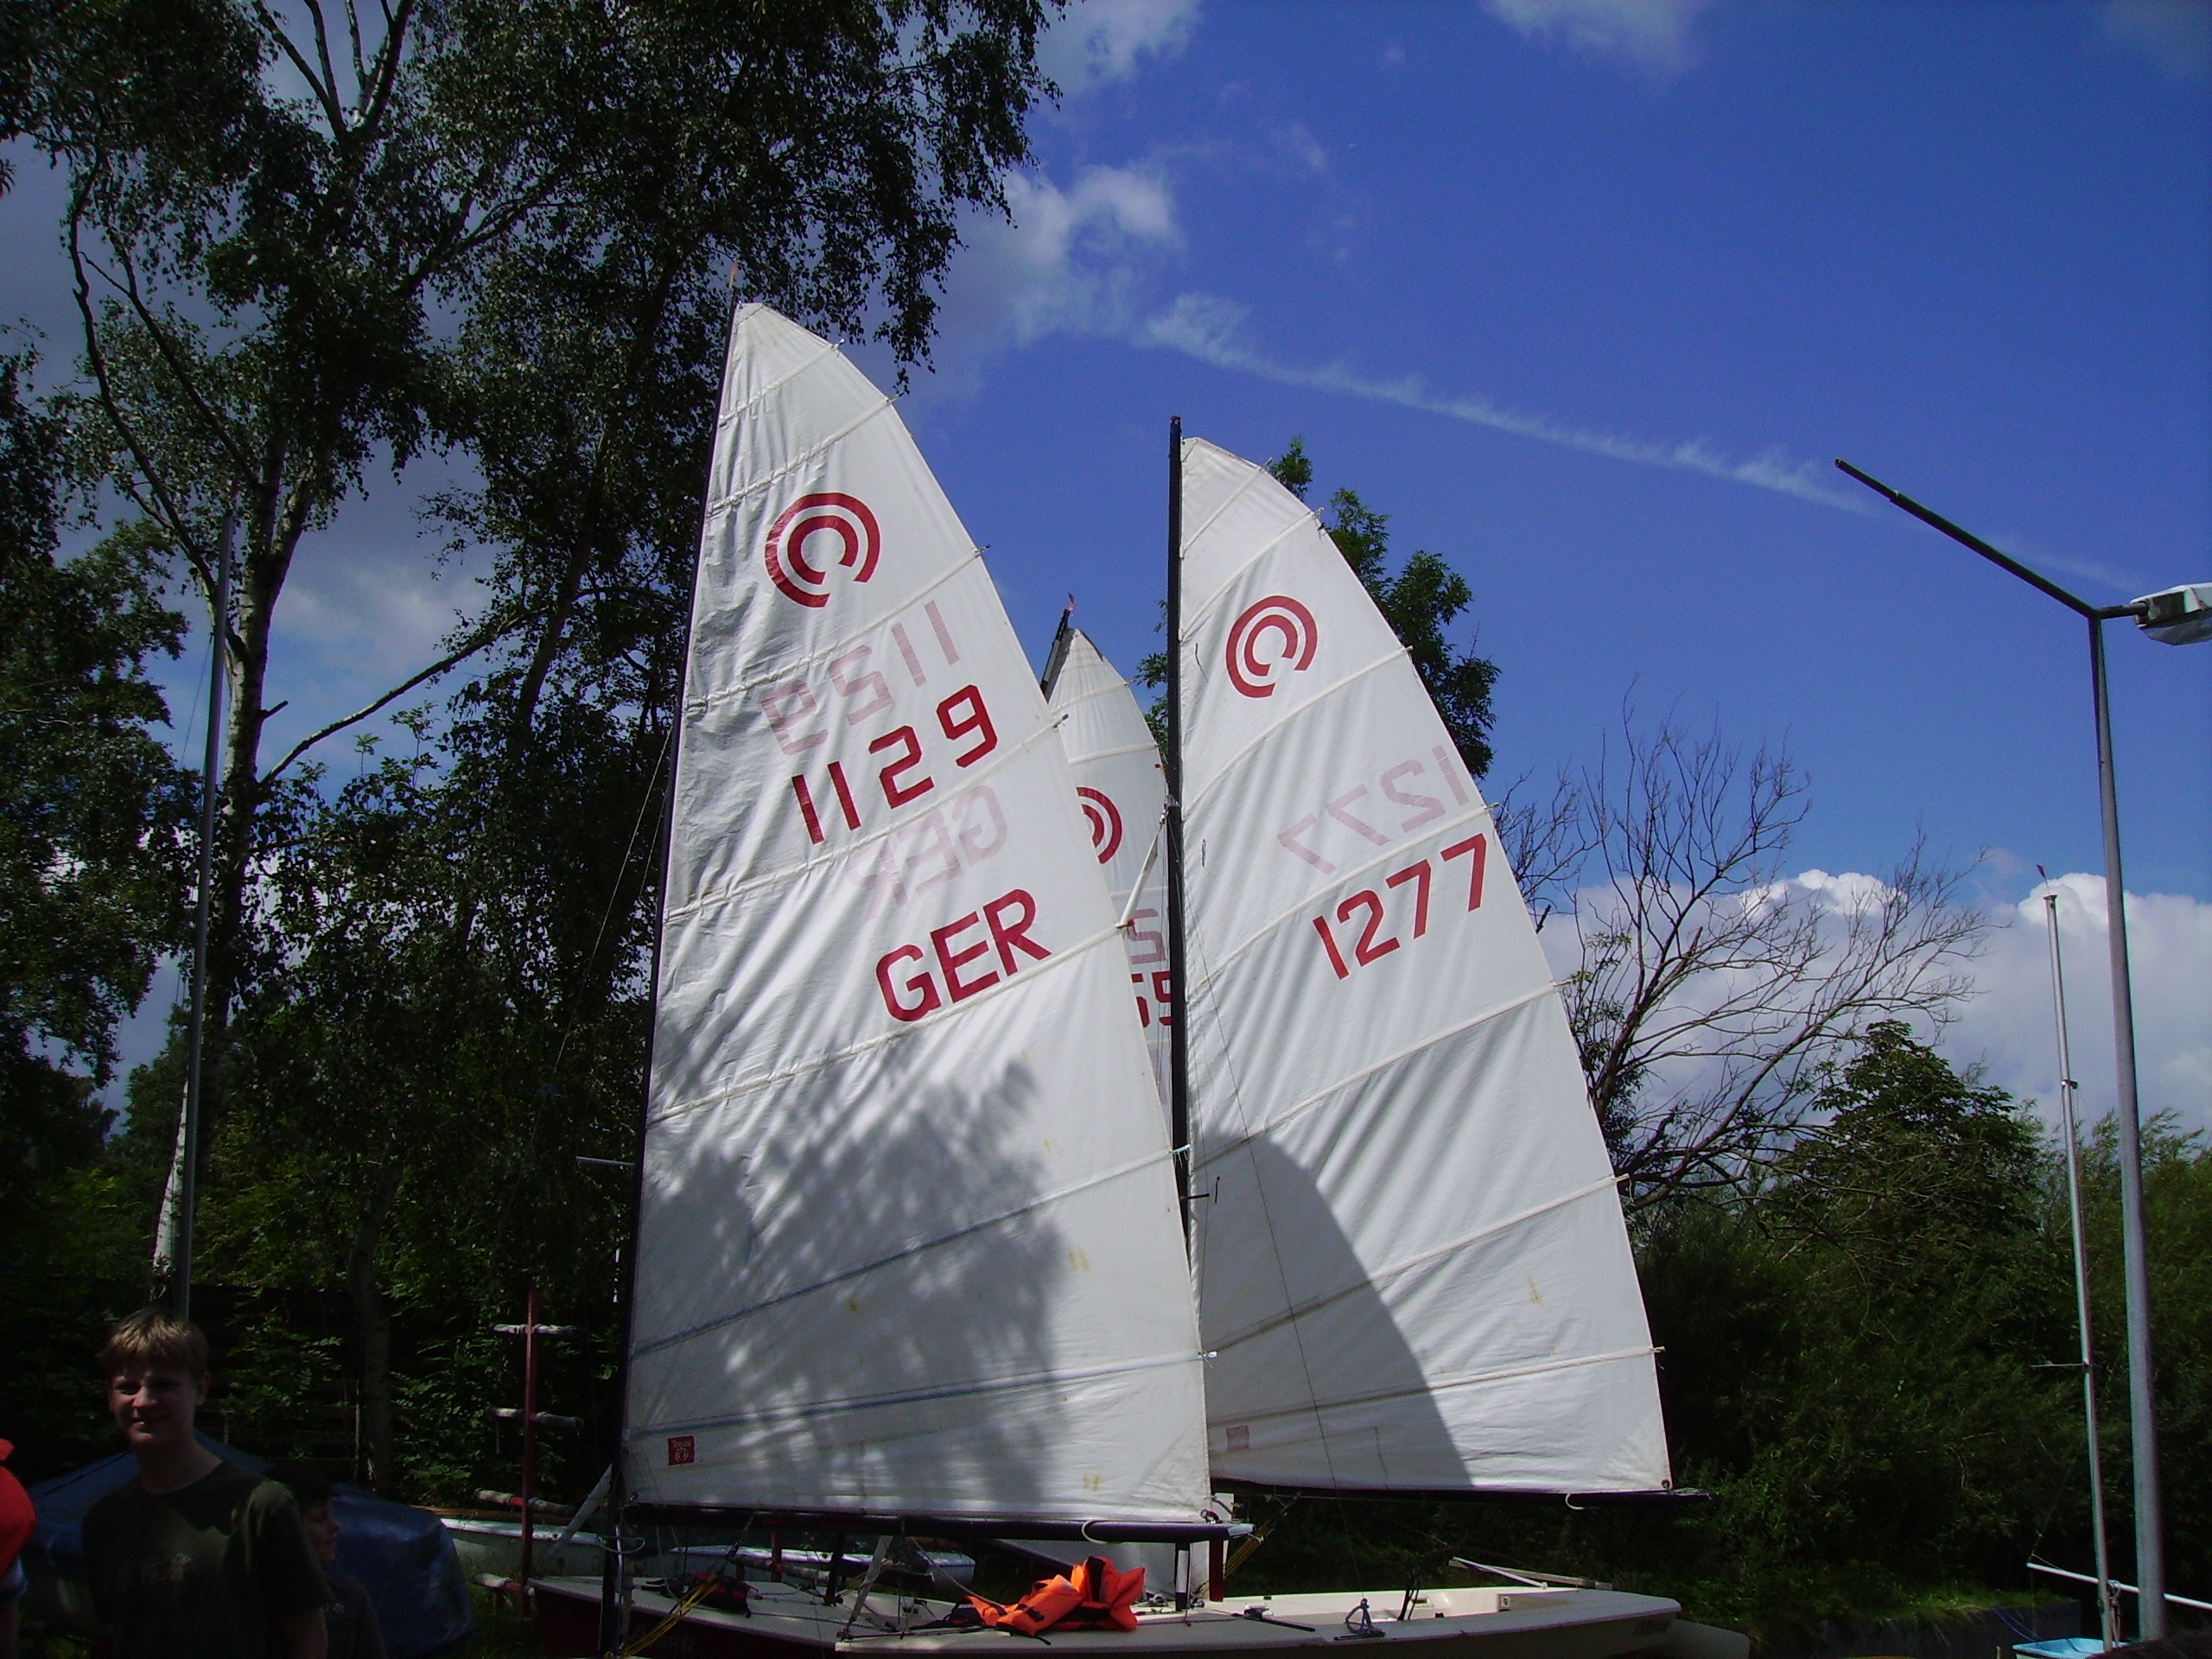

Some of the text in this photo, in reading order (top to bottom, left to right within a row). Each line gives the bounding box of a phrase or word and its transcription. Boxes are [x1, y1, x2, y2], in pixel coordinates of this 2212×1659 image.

[791, 684, 999, 845] 1129
[875, 888, 1052, 1021] GER
[1313, 833, 1487, 980] 1277
